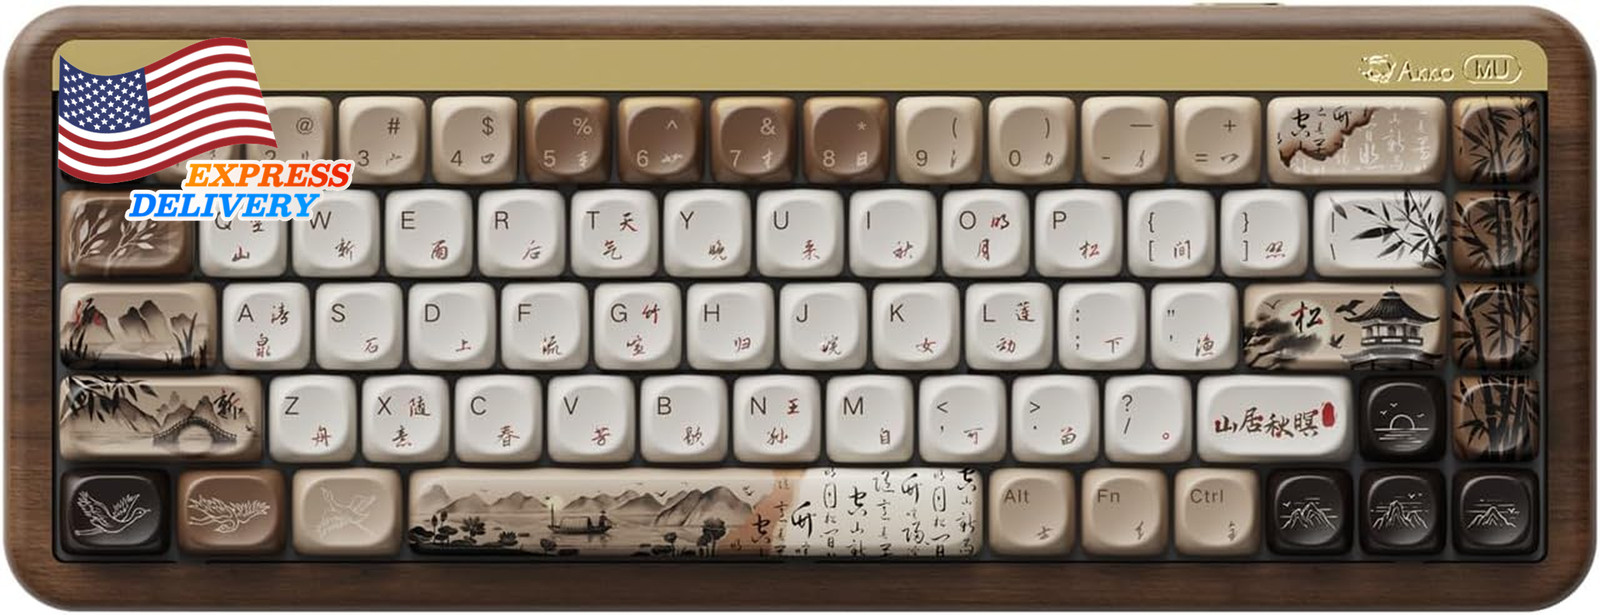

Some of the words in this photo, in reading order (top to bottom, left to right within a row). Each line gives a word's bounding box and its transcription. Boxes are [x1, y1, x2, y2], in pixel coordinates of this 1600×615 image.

[1475, 59, 1509, 80] MU
[296, 117, 313, 134] @
[388, 118, 400, 134] #
[482, 116, 494, 136] $
[573, 118, 592, 134] %
[760, 118, 776, 135] &
[1224, 120, 1236, 132] +
[358, 150, 369, 167] 3
[451, 150, 462, 166] 4
[544, 150, 555, 167] 5
[637, 150, 648, 167] 6
[730, 150, 741, 167] 7
[823, 150, 835, 167] 8
[916, 150, 927, 167] 9
[1009, 150, 1021, 167] 0
[1196, 154, 1208, 162] =
[215, 211, 232, 230] Q
[310, 211, 331, 229] W
[402, 211, 415, 229] E
[495, 211, 508, 229] R
[586, 211, 600, 229] T
[620, 212, 637, 231] 天
[680, 211, 694, 229] Y
[774, 211, 788, 230] U
[959, 211, 976, 230] O
[1053, 211, 1066, 229] P
[232, 247, 250, 261] 山
[978, 239, 989, 260] 月
[238, 304, 254, 322] A
[332, 303, 345, 322] S
[425, 304, 440, 322] D
[518, 304, 531, 322] F
[611, 303, 627, 322] G
[704, 304, 719, 322] H
[796, 304, 807, 323] J
[890, 304, 904, 322] K
[983, 304, 995, 322] L
[365, 337, 379, 354] 石
[456, 340, 472, 352] 上
[916, 338, 937, 354] 女
[1105, 337, 1124, 355] 下
[285, 396, 299, 415] Z
[378, 397, 391, 415] X
[471, 396, 486, 415] C
[564, 397, 578, 415] V
[658, 396, 671, 415] B
[751, 397, 766, 415] N
[788, 398, 799, 414] 王
[844, 397, 863, 415] M
[1122, 394, 1132, 412] ?
[880, 428, 891, 446] 自
[964, 428, 984, 446] 可
[1003, 488, 1028, 504] Alt
[1097, 488, 1120, 503] Fn
[1188, 487, 1223, 503] Ctrl
